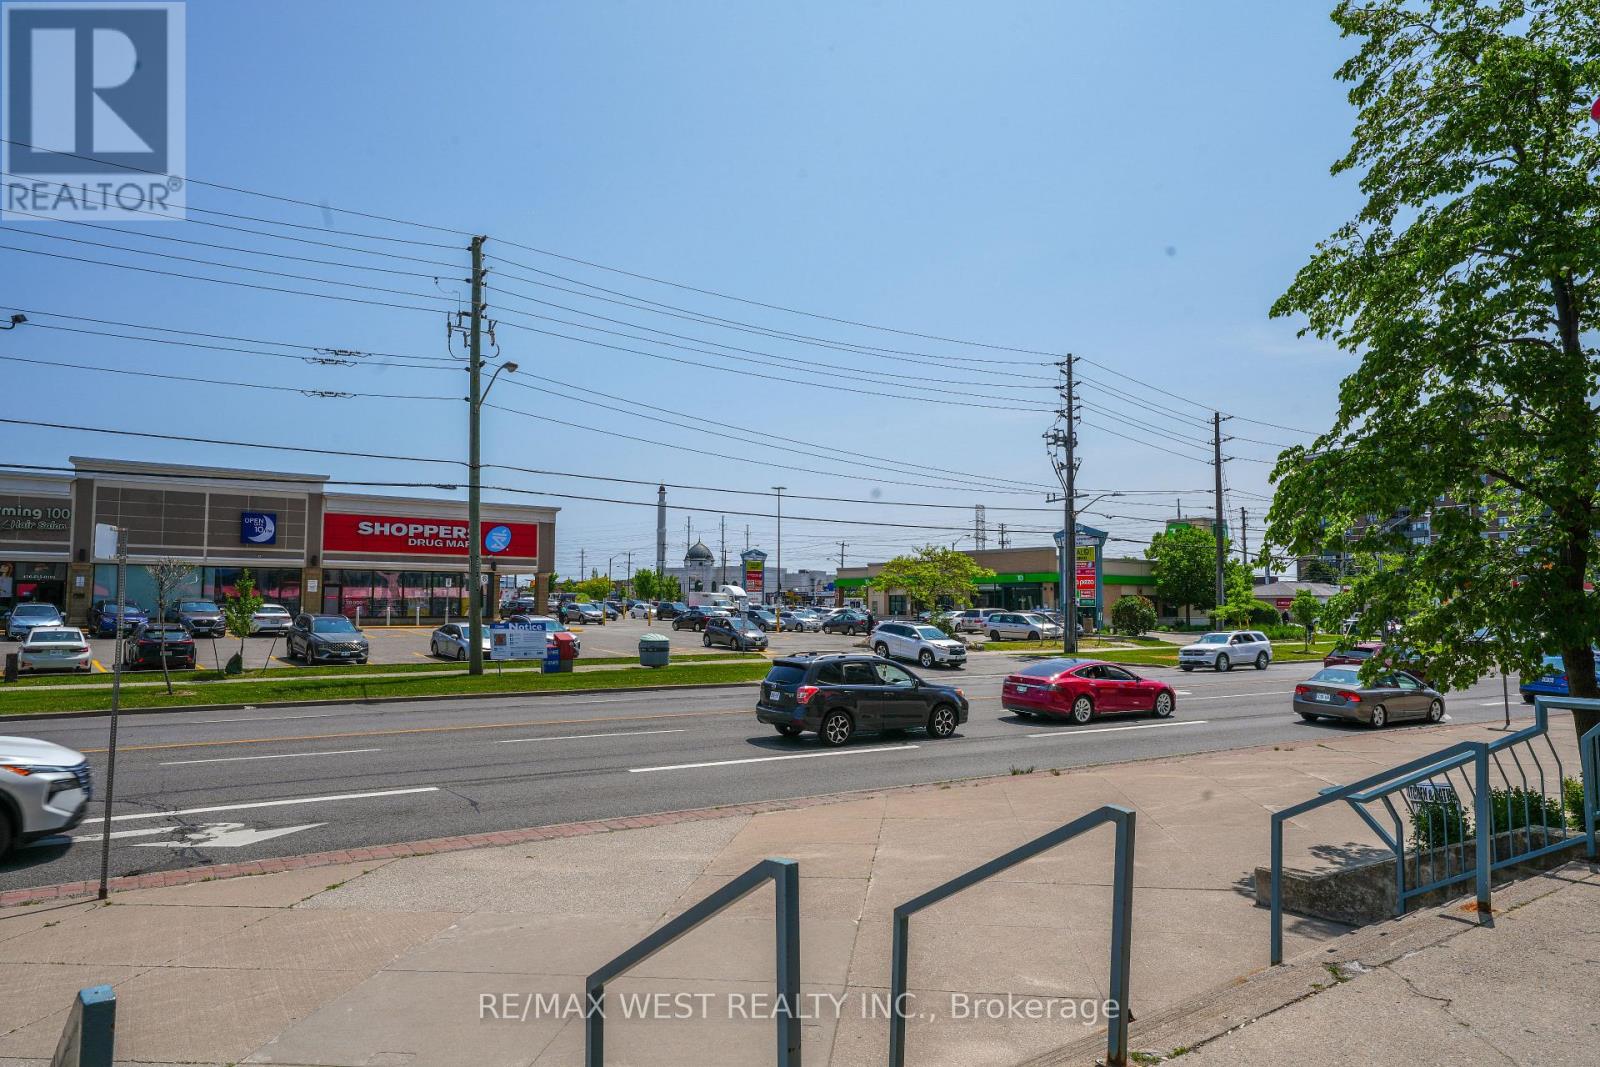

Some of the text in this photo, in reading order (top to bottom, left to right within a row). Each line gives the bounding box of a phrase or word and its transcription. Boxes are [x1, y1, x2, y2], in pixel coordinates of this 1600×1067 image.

[47, 508, 71, 519] 100
[408, 538, 443, 547] DRUG
[508, 622, 543, 631] Notice
